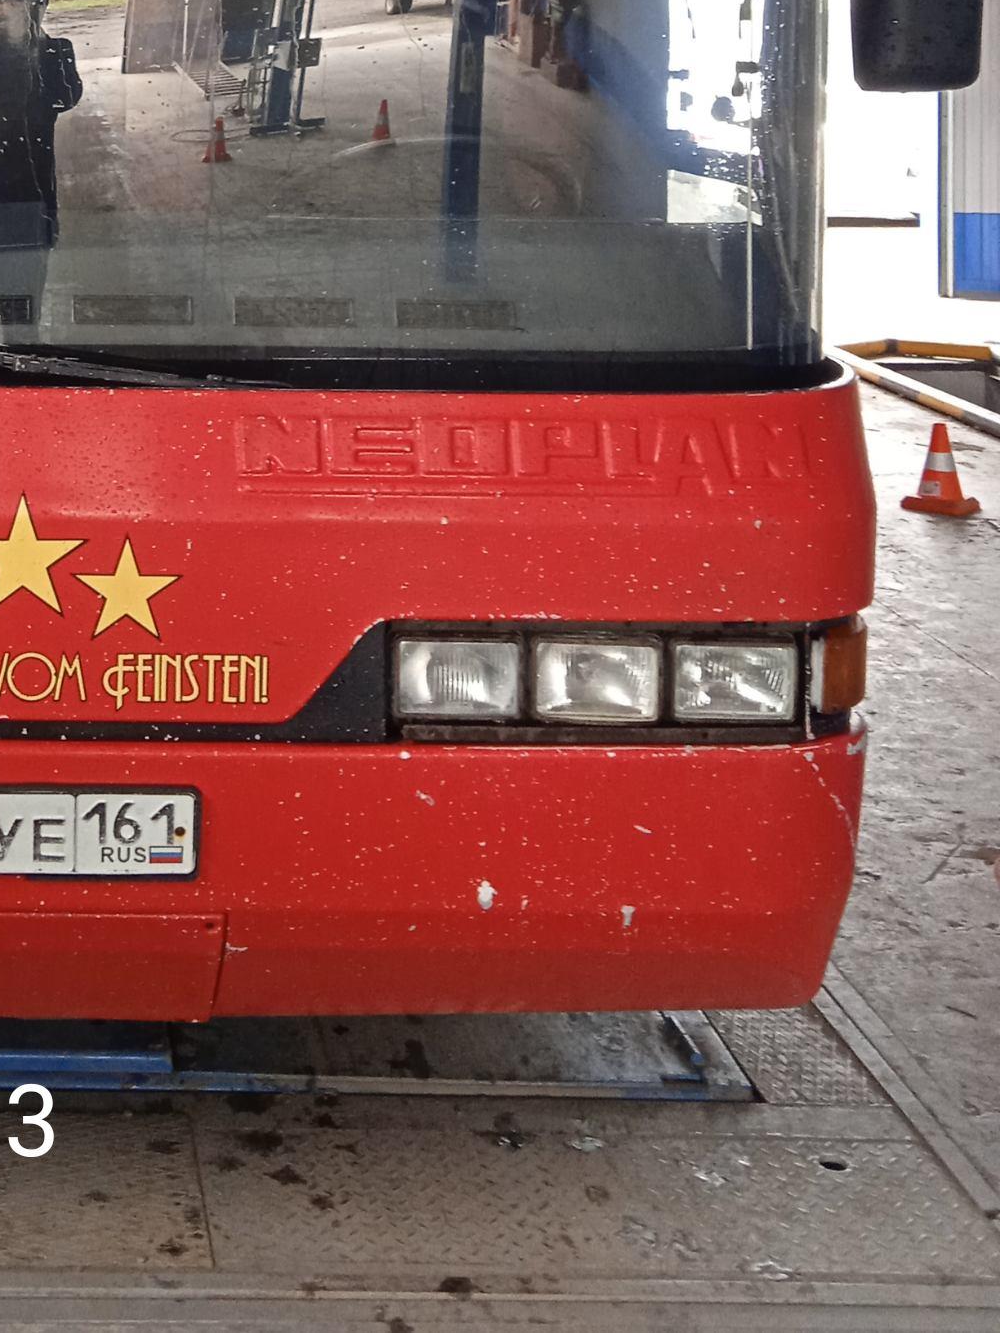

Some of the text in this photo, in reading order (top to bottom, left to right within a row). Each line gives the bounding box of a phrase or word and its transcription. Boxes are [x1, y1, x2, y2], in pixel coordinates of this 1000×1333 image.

[234, 414, 810, 497] NEOPLAN
[102, 653, 270, 710] FEINSTEN!
[81, 801, 176, 845] 161
[100, 846, 147, 864] RUS
